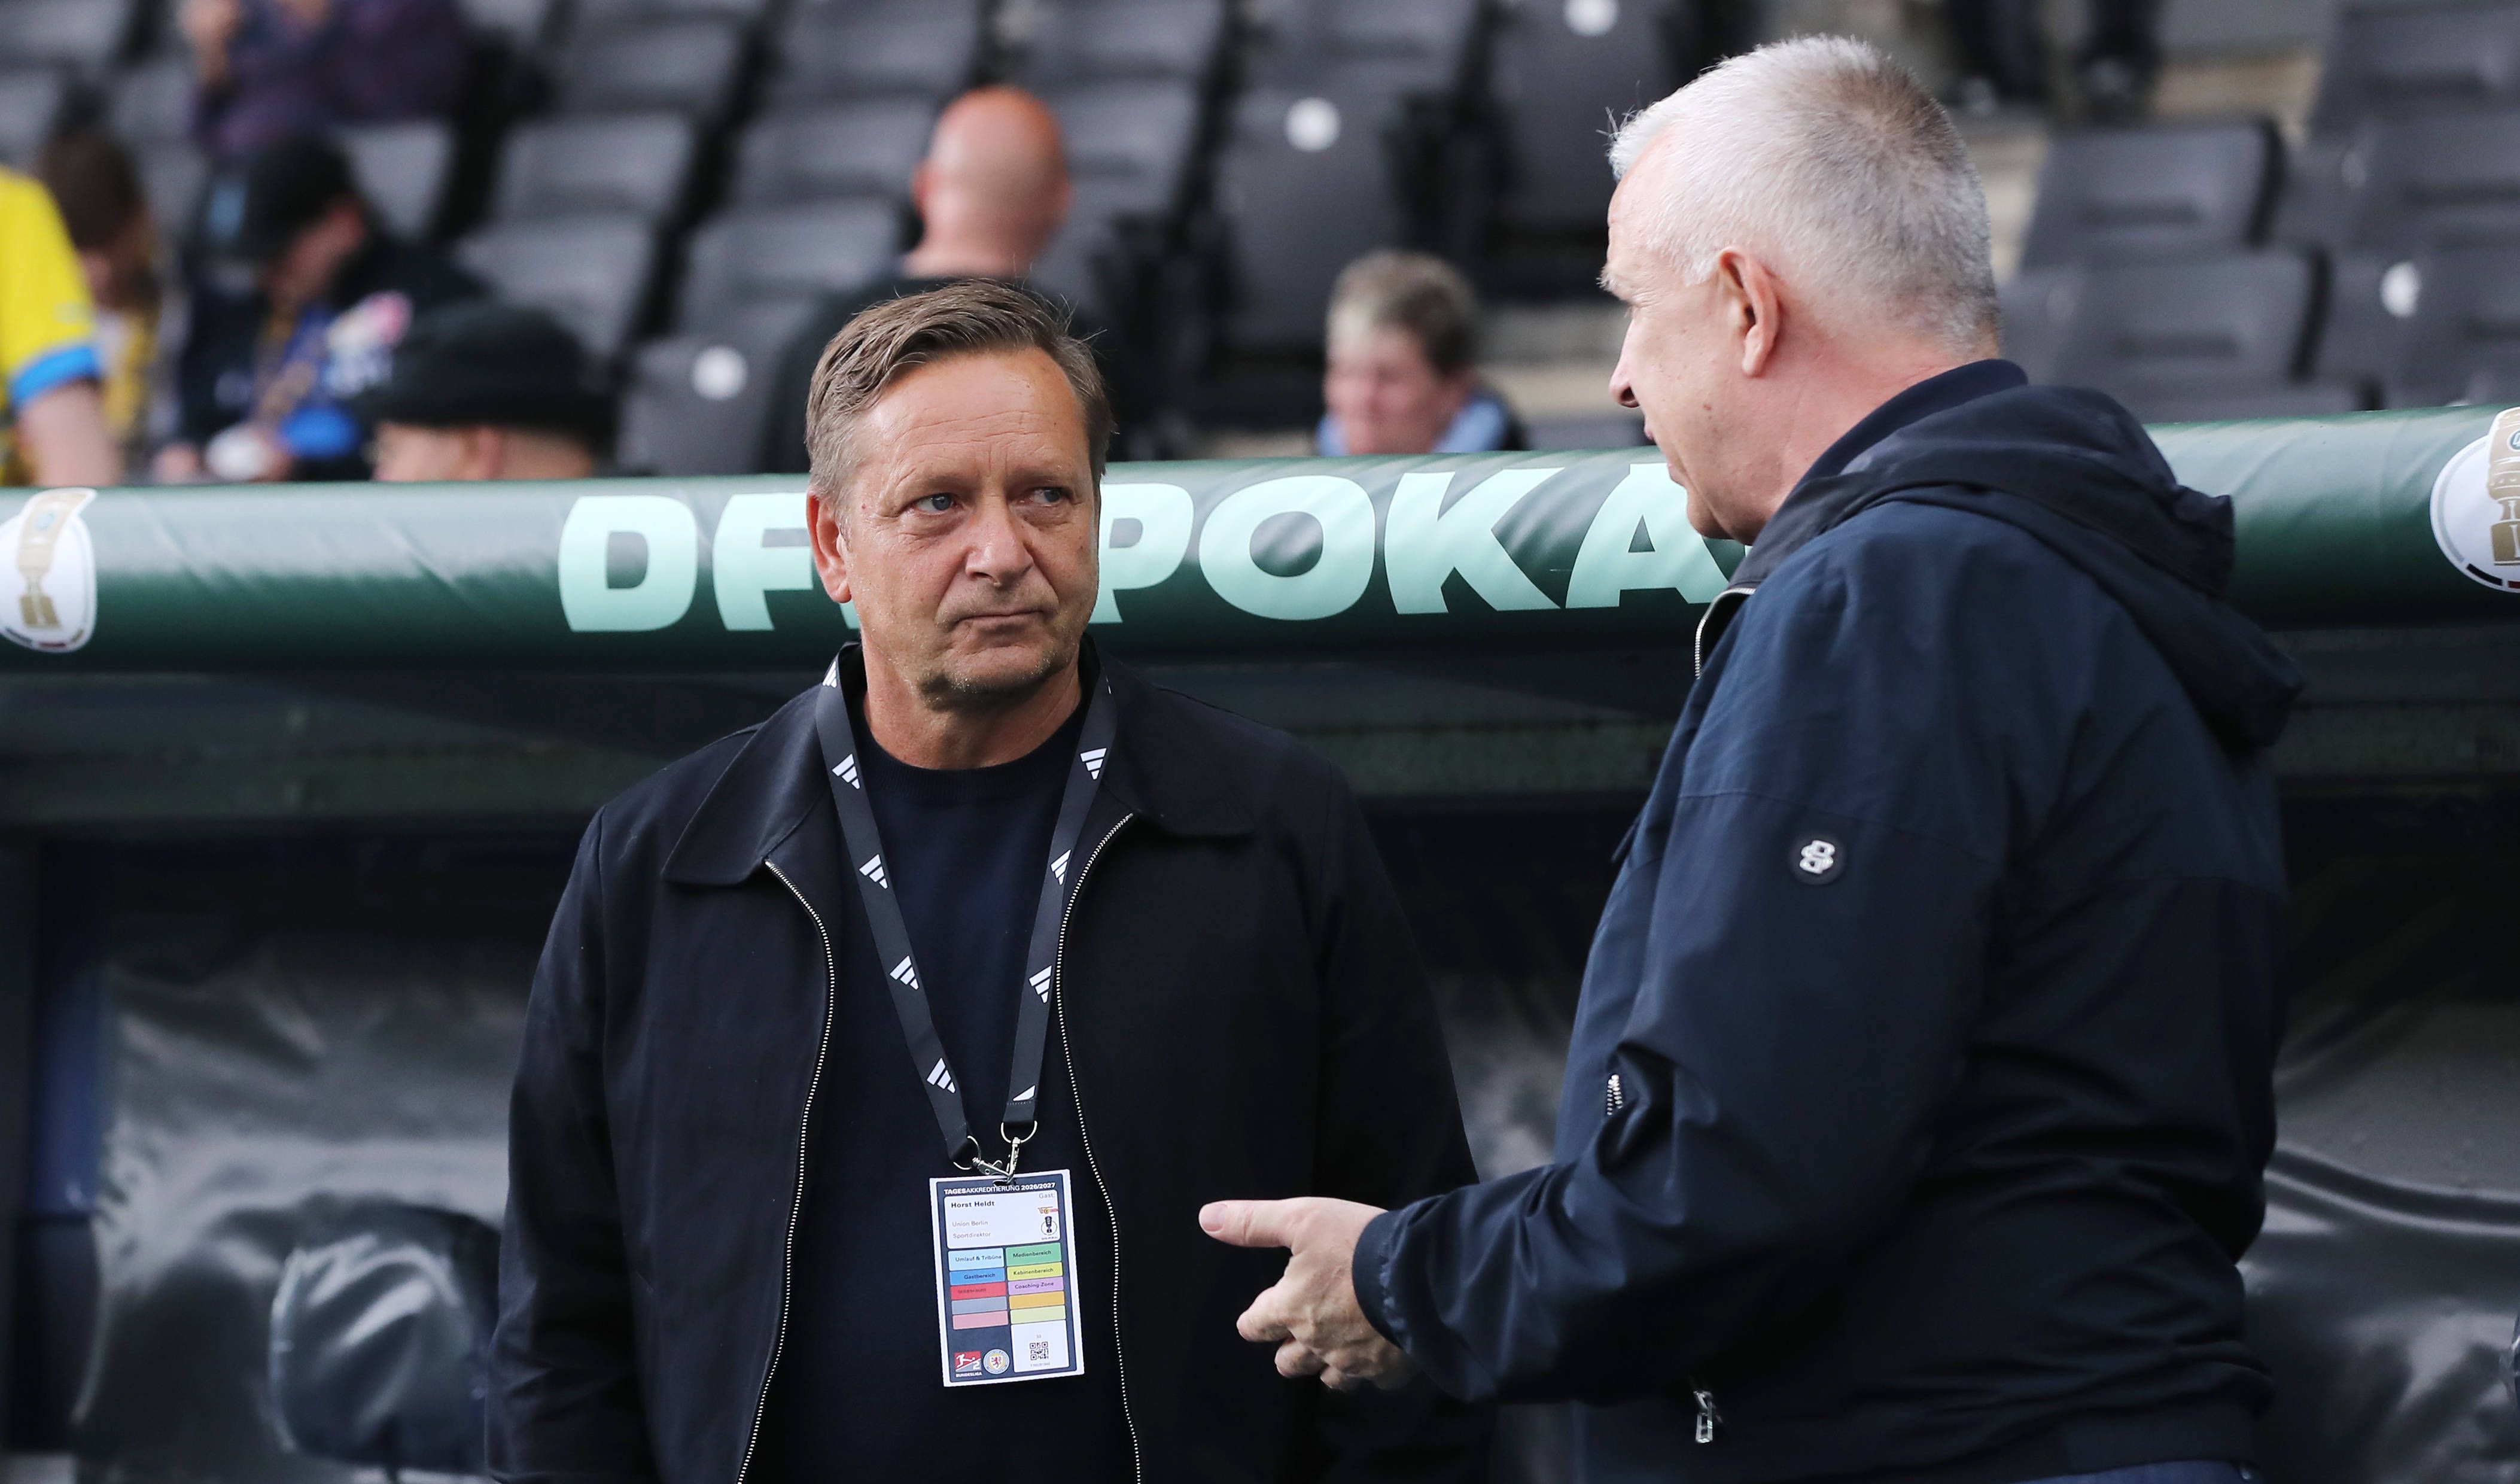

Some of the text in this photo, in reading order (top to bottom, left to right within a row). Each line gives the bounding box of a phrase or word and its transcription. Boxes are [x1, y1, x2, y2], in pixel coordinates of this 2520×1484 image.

[558, 463, 1753, 632] DF POKA
[944, 1185, 1020, 1194] TAGESAKKREDITIERUNG
[952, 1231, 991, 1239] Sportdirektor
[1012, 1249, 1052, 1258] Medienbereich
[1013, 1267, 1054, 1276] Kabinenbereich
[1015, 1281, 1054, 1290] Coaching-Zone
[973, 1361, 980, 1370] 2
